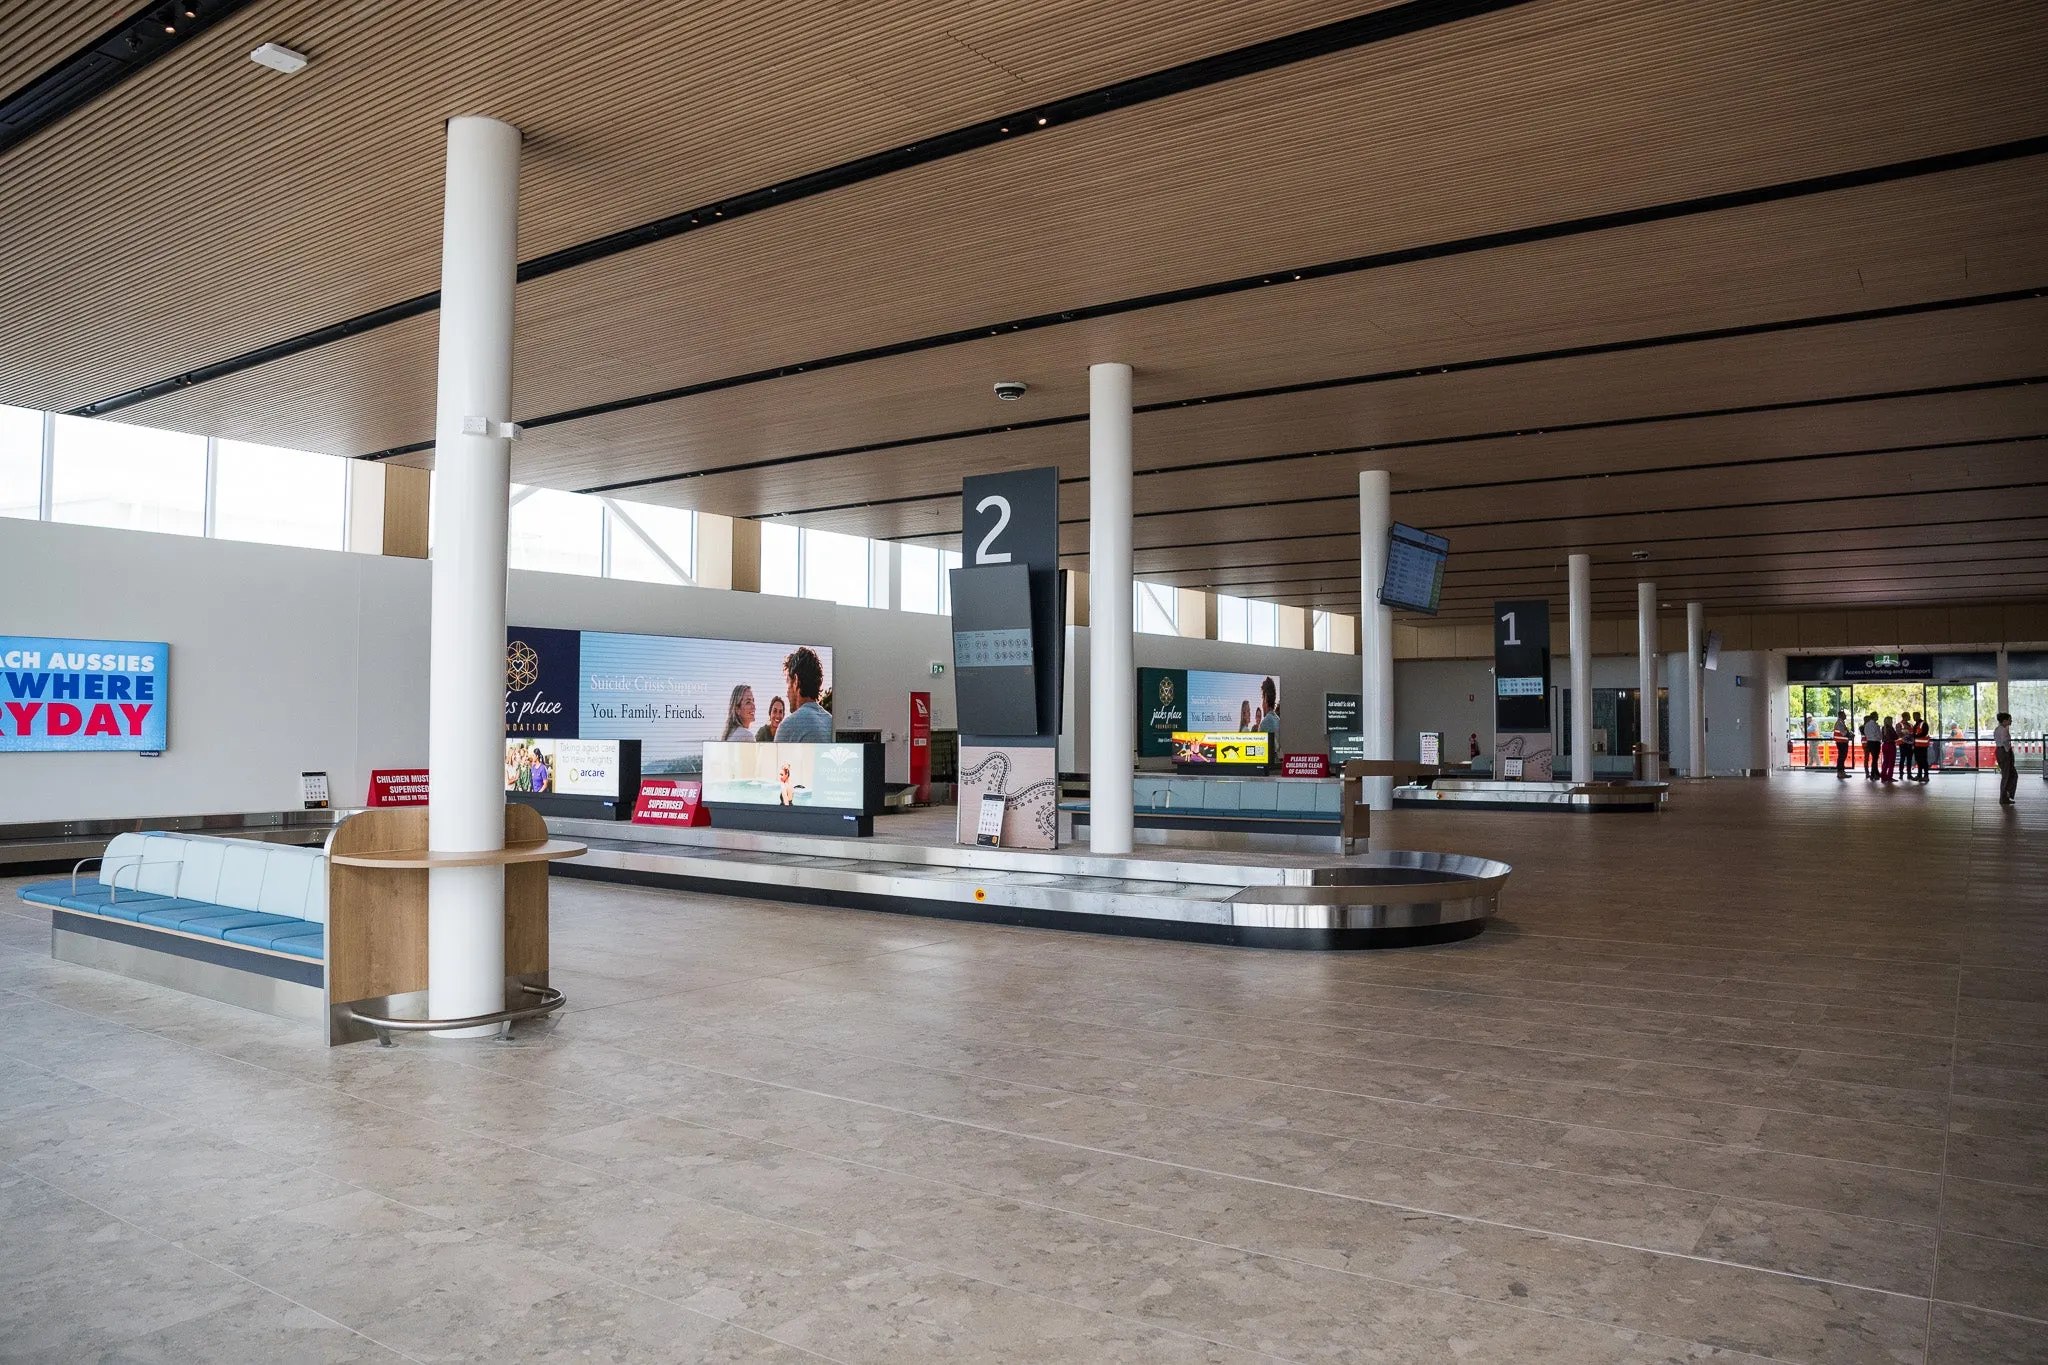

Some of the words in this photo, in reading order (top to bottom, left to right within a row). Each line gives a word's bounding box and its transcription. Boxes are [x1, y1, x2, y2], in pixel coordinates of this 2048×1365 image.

[975, 495, 1012, 564] 2
[1501, 612, 1521, 645] 1
[0, 650, 41, 669] CH
[47, 652, 155, 672] AUSSIES
[0, 672, 154, 700] WHERE
[590, 674, 632, 691] Suicide
[634, 675, 664, 691] Crisis
[667, 677, 709, 696] Support
[517, 690, 563, 723] place
[591, 704, 617, 720] You.
[620, 704, 661, 723] Family.
[664, 704, 705, 720] Friends.
[0, 701, 153, 737] YDAY
[560, 742, 581, 754] Taking
[581, 744, 600, 756] aged
[601, 745, 616, 753] care
[571, 756, 586, 764] new
[376, 775, 409, 784] CHILDREN
[411, 774, 429, 783] MUST
[580, 769, 605, 778] arcare
[389, 785, 429, 794] SUPERVISED
[641, 786, 671, 796] CHILDREN
[670, 787, 688, 798] MUST
[688, 788, 699, 798] BE
[648, 799, 684, 810] SUPERVISED
